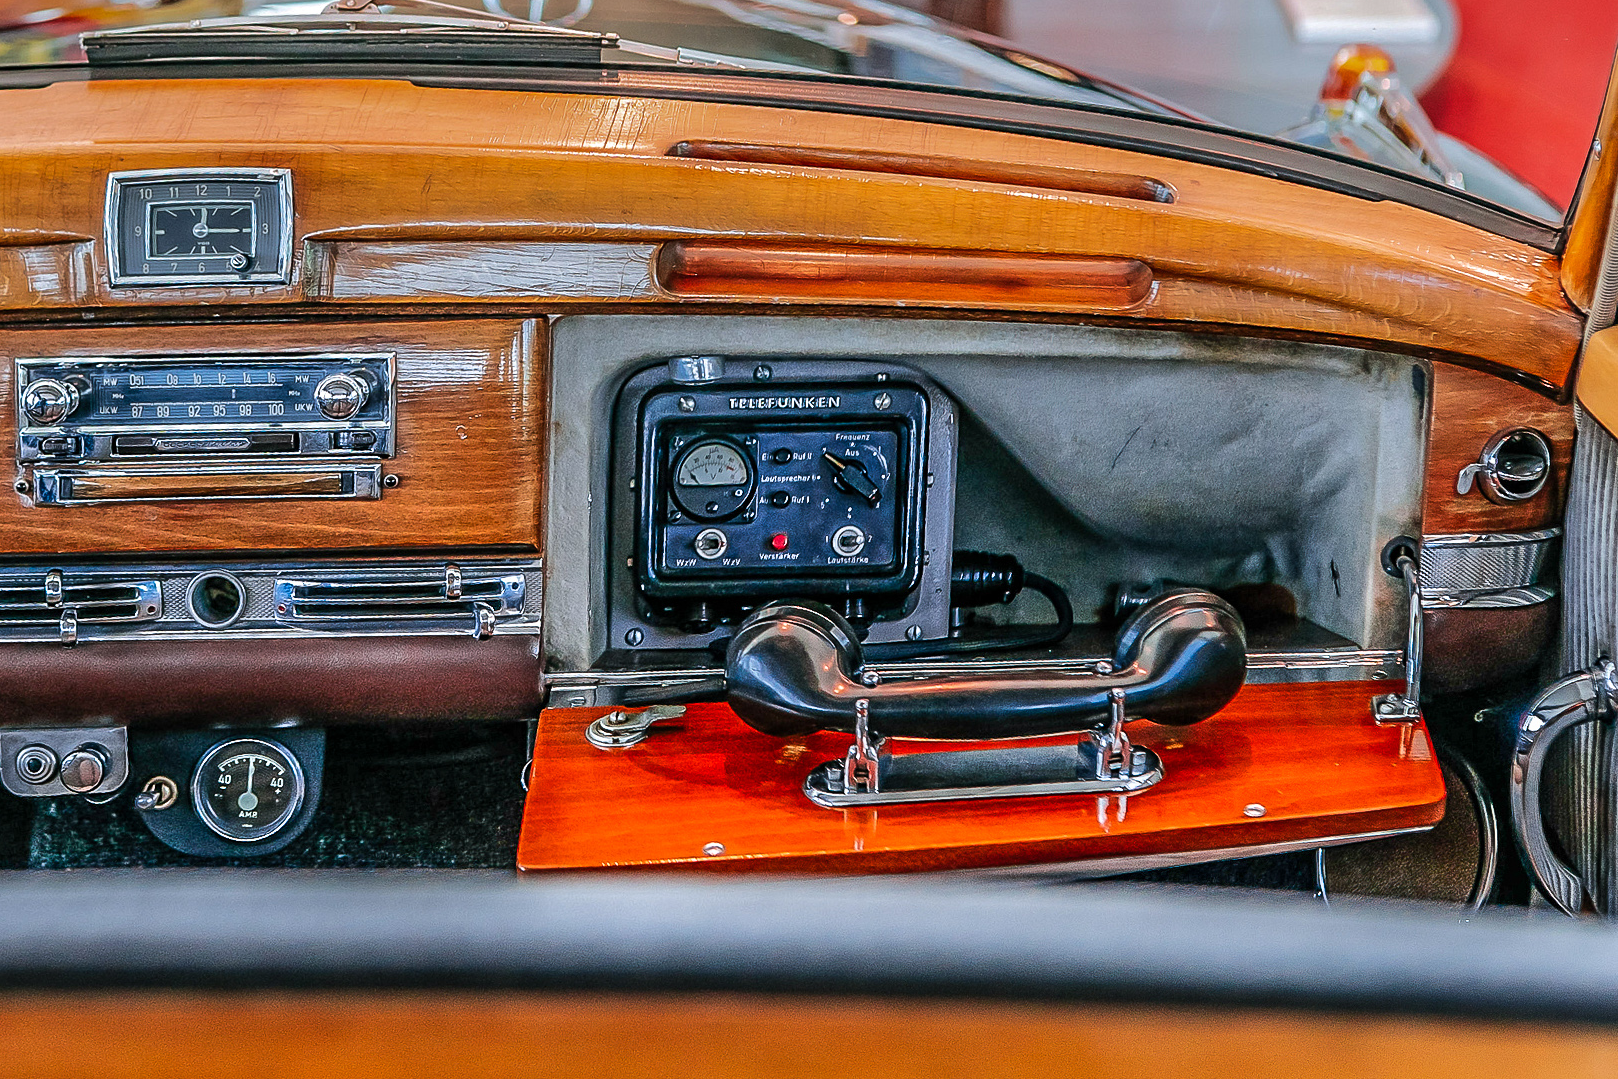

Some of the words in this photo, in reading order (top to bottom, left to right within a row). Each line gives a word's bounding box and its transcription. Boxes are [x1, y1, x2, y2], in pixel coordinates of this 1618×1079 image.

[139, 188, 153, 200] 10
[169, 187, 179, 198] 11
[195, 184, 208, 196] 12
[226, 186, 232, 197] 1
[254, 186, 261, 197] 2
[134, 226, 142, 237] 9
[262, 223, 269, 234] 3
[142, 263, 150, 274] 8
[171, 263, 178, 273] 7
[198, 262, 205, 273] 6
[226, 262, 233, 272] 5
[254, 261, 261, 272] 4
[103, 378, 118, 386] MW
[193, 373, 202, 384] 10
[218, 372, 227, 384] 12
[243, 372, 251, 384] 14
[268, 372, 276, 383] 16
[295, 375, 310, 383] MW
[729, 396, 840, 409] TELEFUNKEN
[99, 405, 119, 415] UKW
[131, 406, 143, 418] 87
[157, 406, 170, 417] 89
[188, 405, 201, 417] 92
[213, 405, 226, 416] 95
[239, 404, 252, 416] 98
[268, 404, 284, 416] 100
[294, 403, 313, 411] UKW
[835, 433, 870, 441] Frequenz
[793, 452, 806, 461] Ruf
[844, 448, 860, 457] Aus
[761, 474, 811, 483] Lautsprecher
[792, 495, 805, 504] Ruf
[759, 552, 800, 561] Verstärker
[827, 555, 869, 564] Lautstärke
[218, 774, 232, 784] 40
[270, 778, 284, 788] 40
